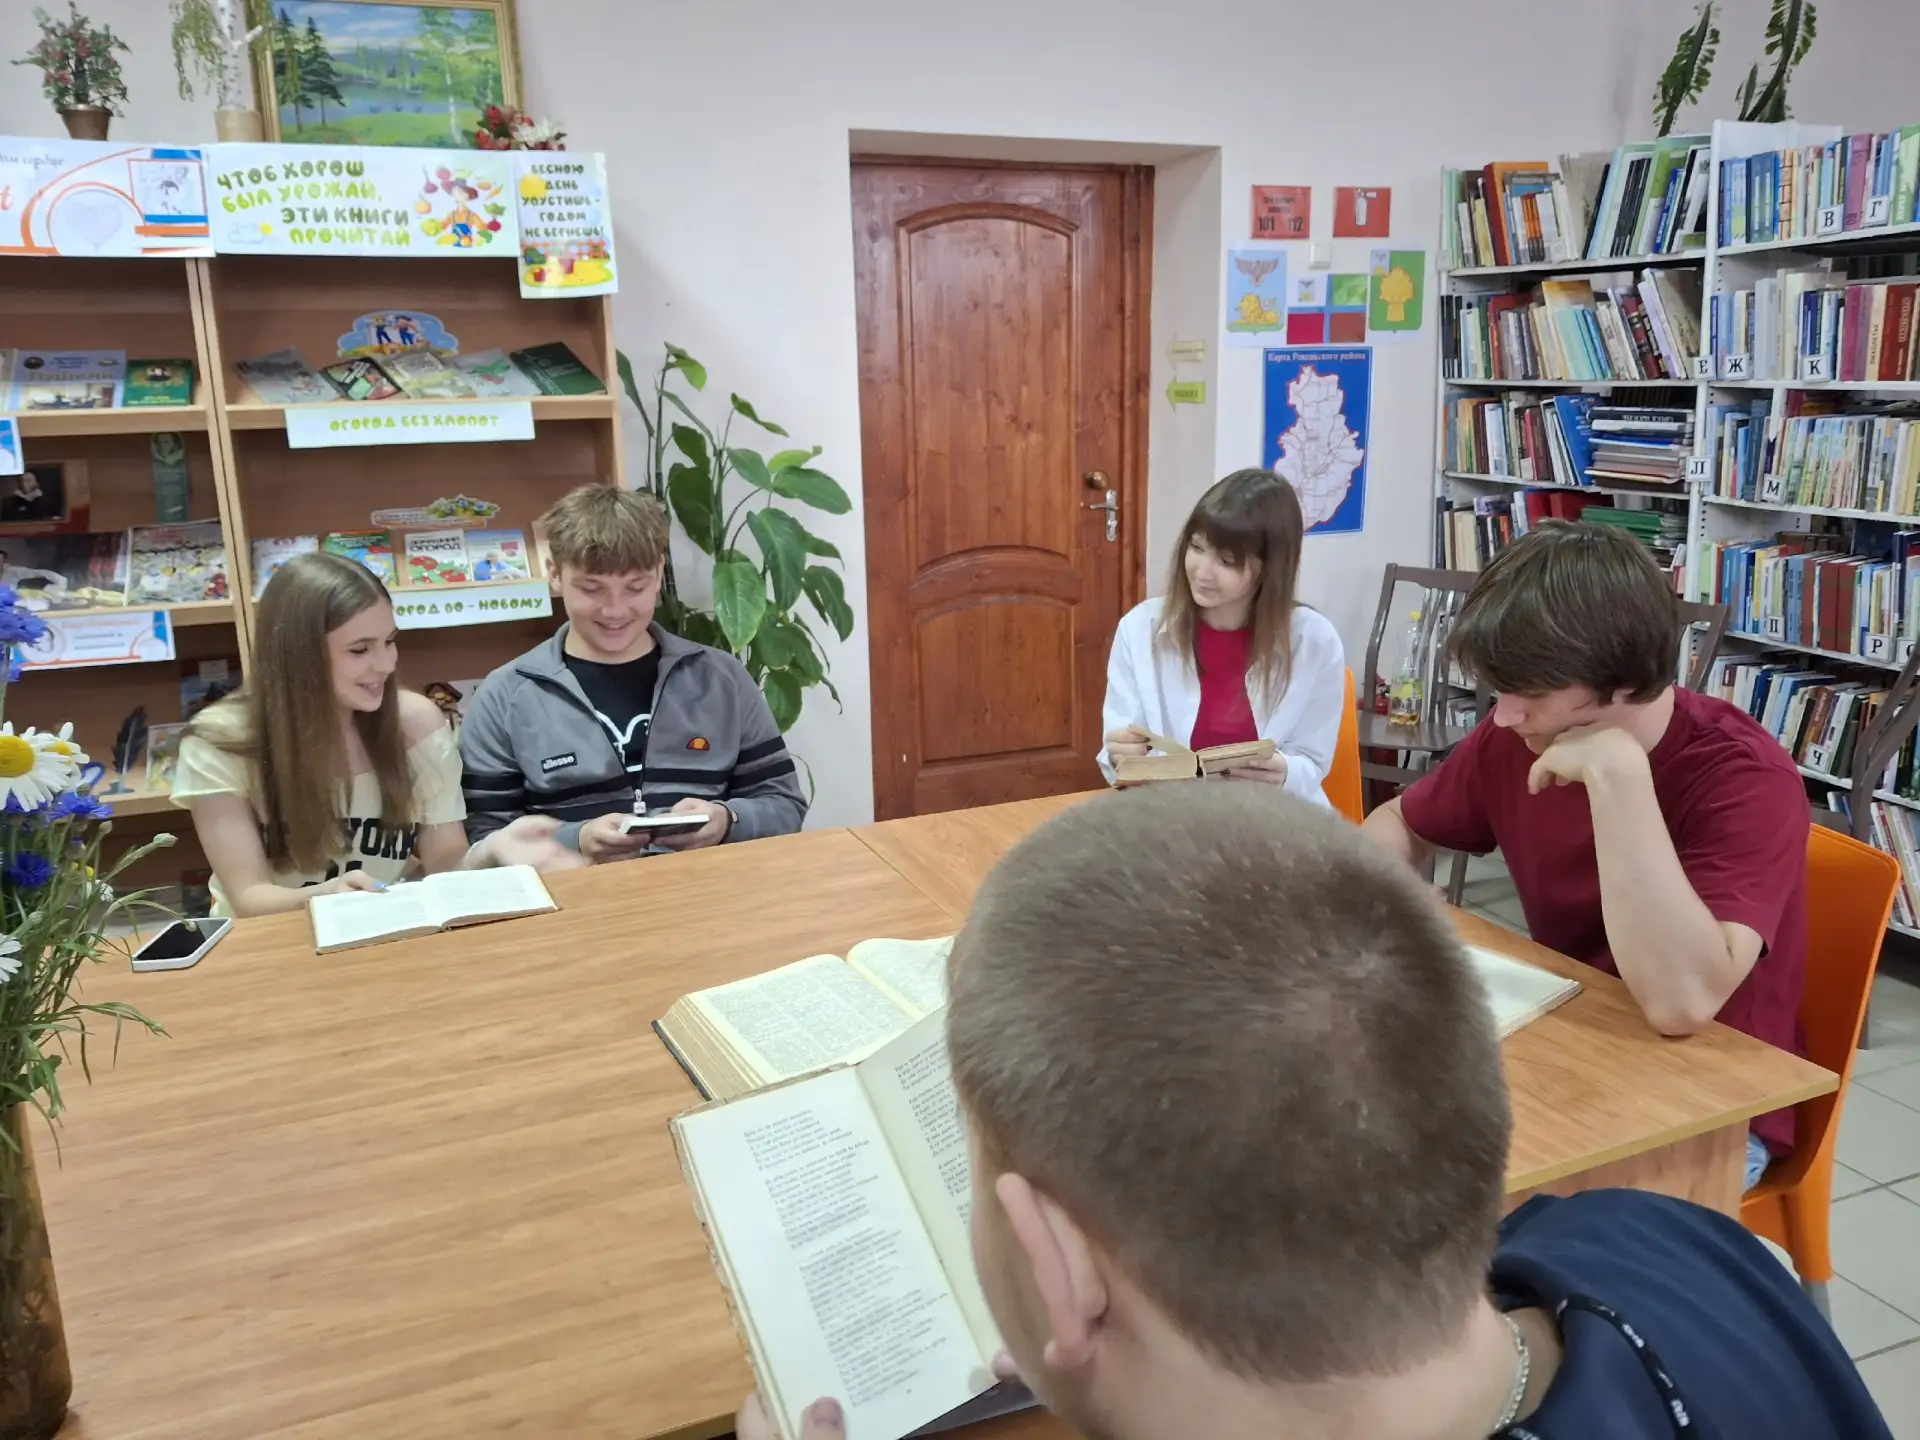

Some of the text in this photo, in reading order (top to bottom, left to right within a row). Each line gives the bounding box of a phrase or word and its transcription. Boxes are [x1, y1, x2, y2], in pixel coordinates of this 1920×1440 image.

[217, 160, 365, 190] ЧТОБ ХОРОШ
[544, 180, 578, 190] ДЕНЬ
[221, 180, 382, 213] БЫЛ УРОЖАЙ,
[521, 196, 592, 206] УПУСТИШЬ
[281, 207, 409, 226] ЭТИ КНИГИ
[540, 212, 586, 222] ГОДОМ
[1870, 200, 1882, 218] Г
[1259, 215, 1304, 232] 101 112
[1823, 210, 1834, 228] В
[289, 226, 411, 245] ПРОЧИТАЙ
[525, 229, 540, 237] НЕ
[1698, 359, 1708, 374] Е
[1728, 357, 1744, 373] Ж
[1809, 359, 1821, 375] К
[329, 415, 499, 431] ОГОРОД БЕЗ ХЛОПОТ
[1766, 480, 1780, 496] М
[409, 543, 461, 552] ОГОРОД
[393, 603, 440, 616] ОРОД
[1871, 638, 1883, 654] Р
[543, 755, 574, 770] ellesse
[1811, 749, 1825, 766] Ч
